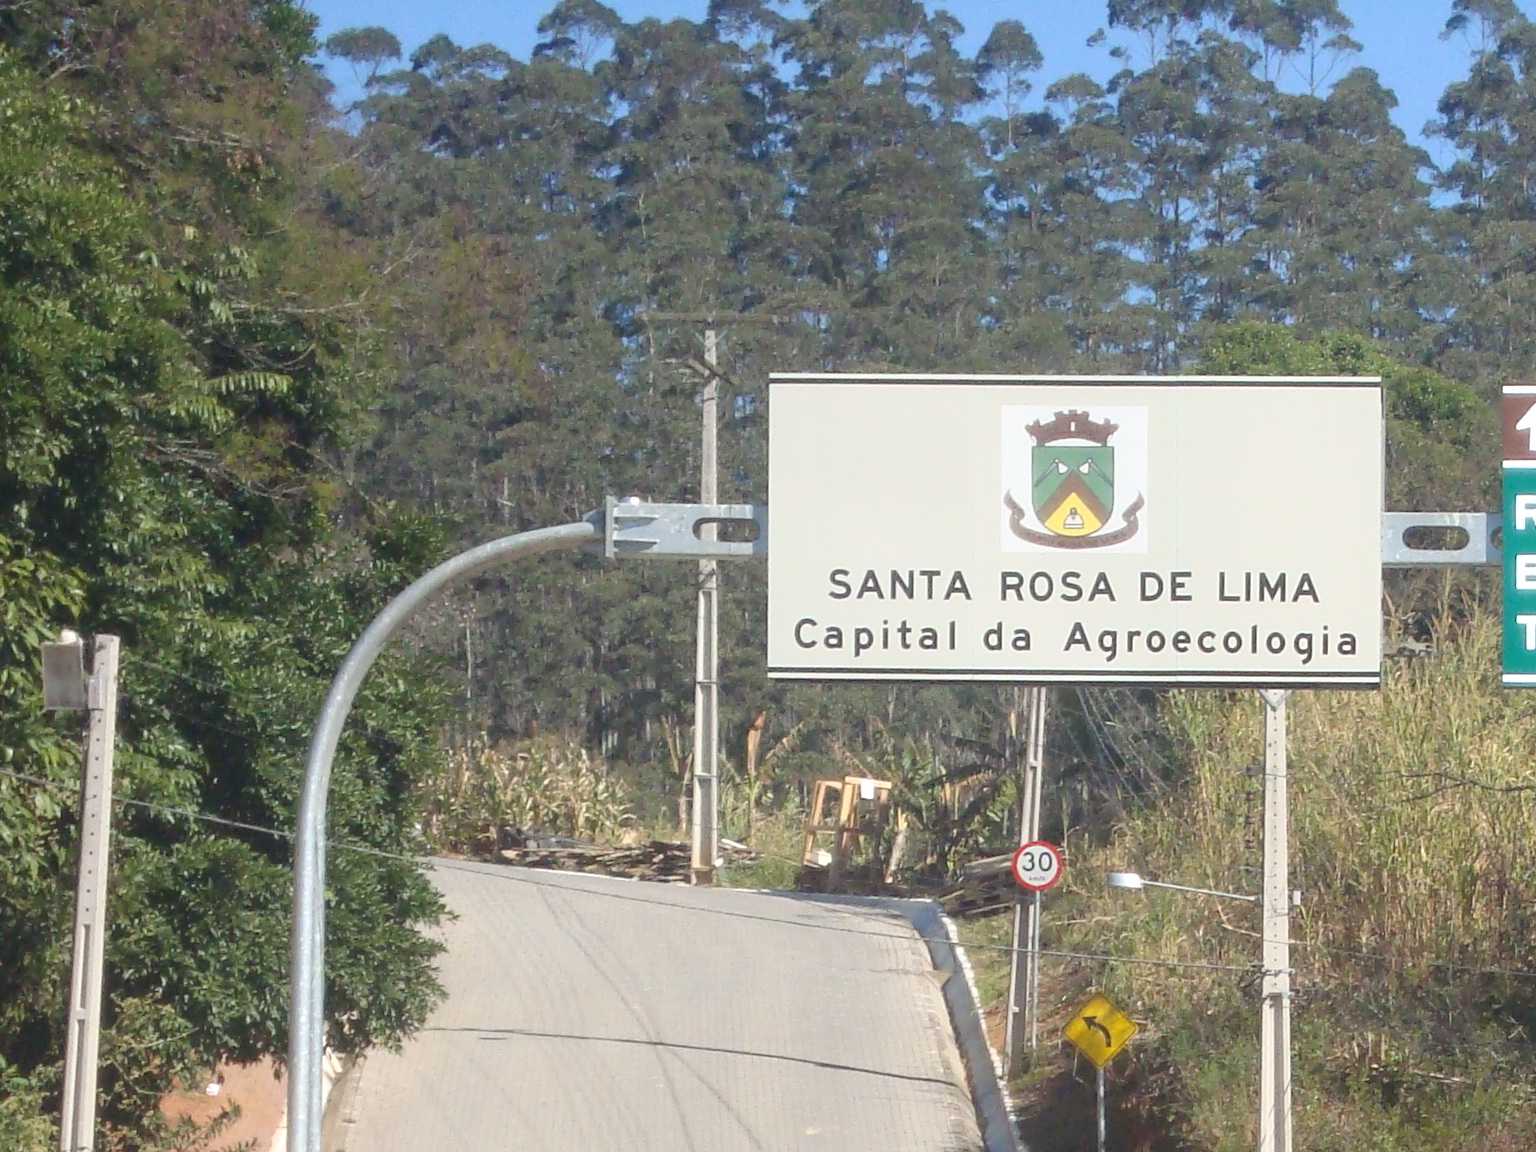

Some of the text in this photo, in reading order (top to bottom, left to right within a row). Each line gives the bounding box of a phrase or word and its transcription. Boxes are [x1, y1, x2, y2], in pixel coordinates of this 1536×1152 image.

[828, 568, 1321, 603] SANTA ROSA DE LIMA
[794, 618, 1358, 665] Capital da Agroecologia
[1022, 851, 1053, 872] 30
